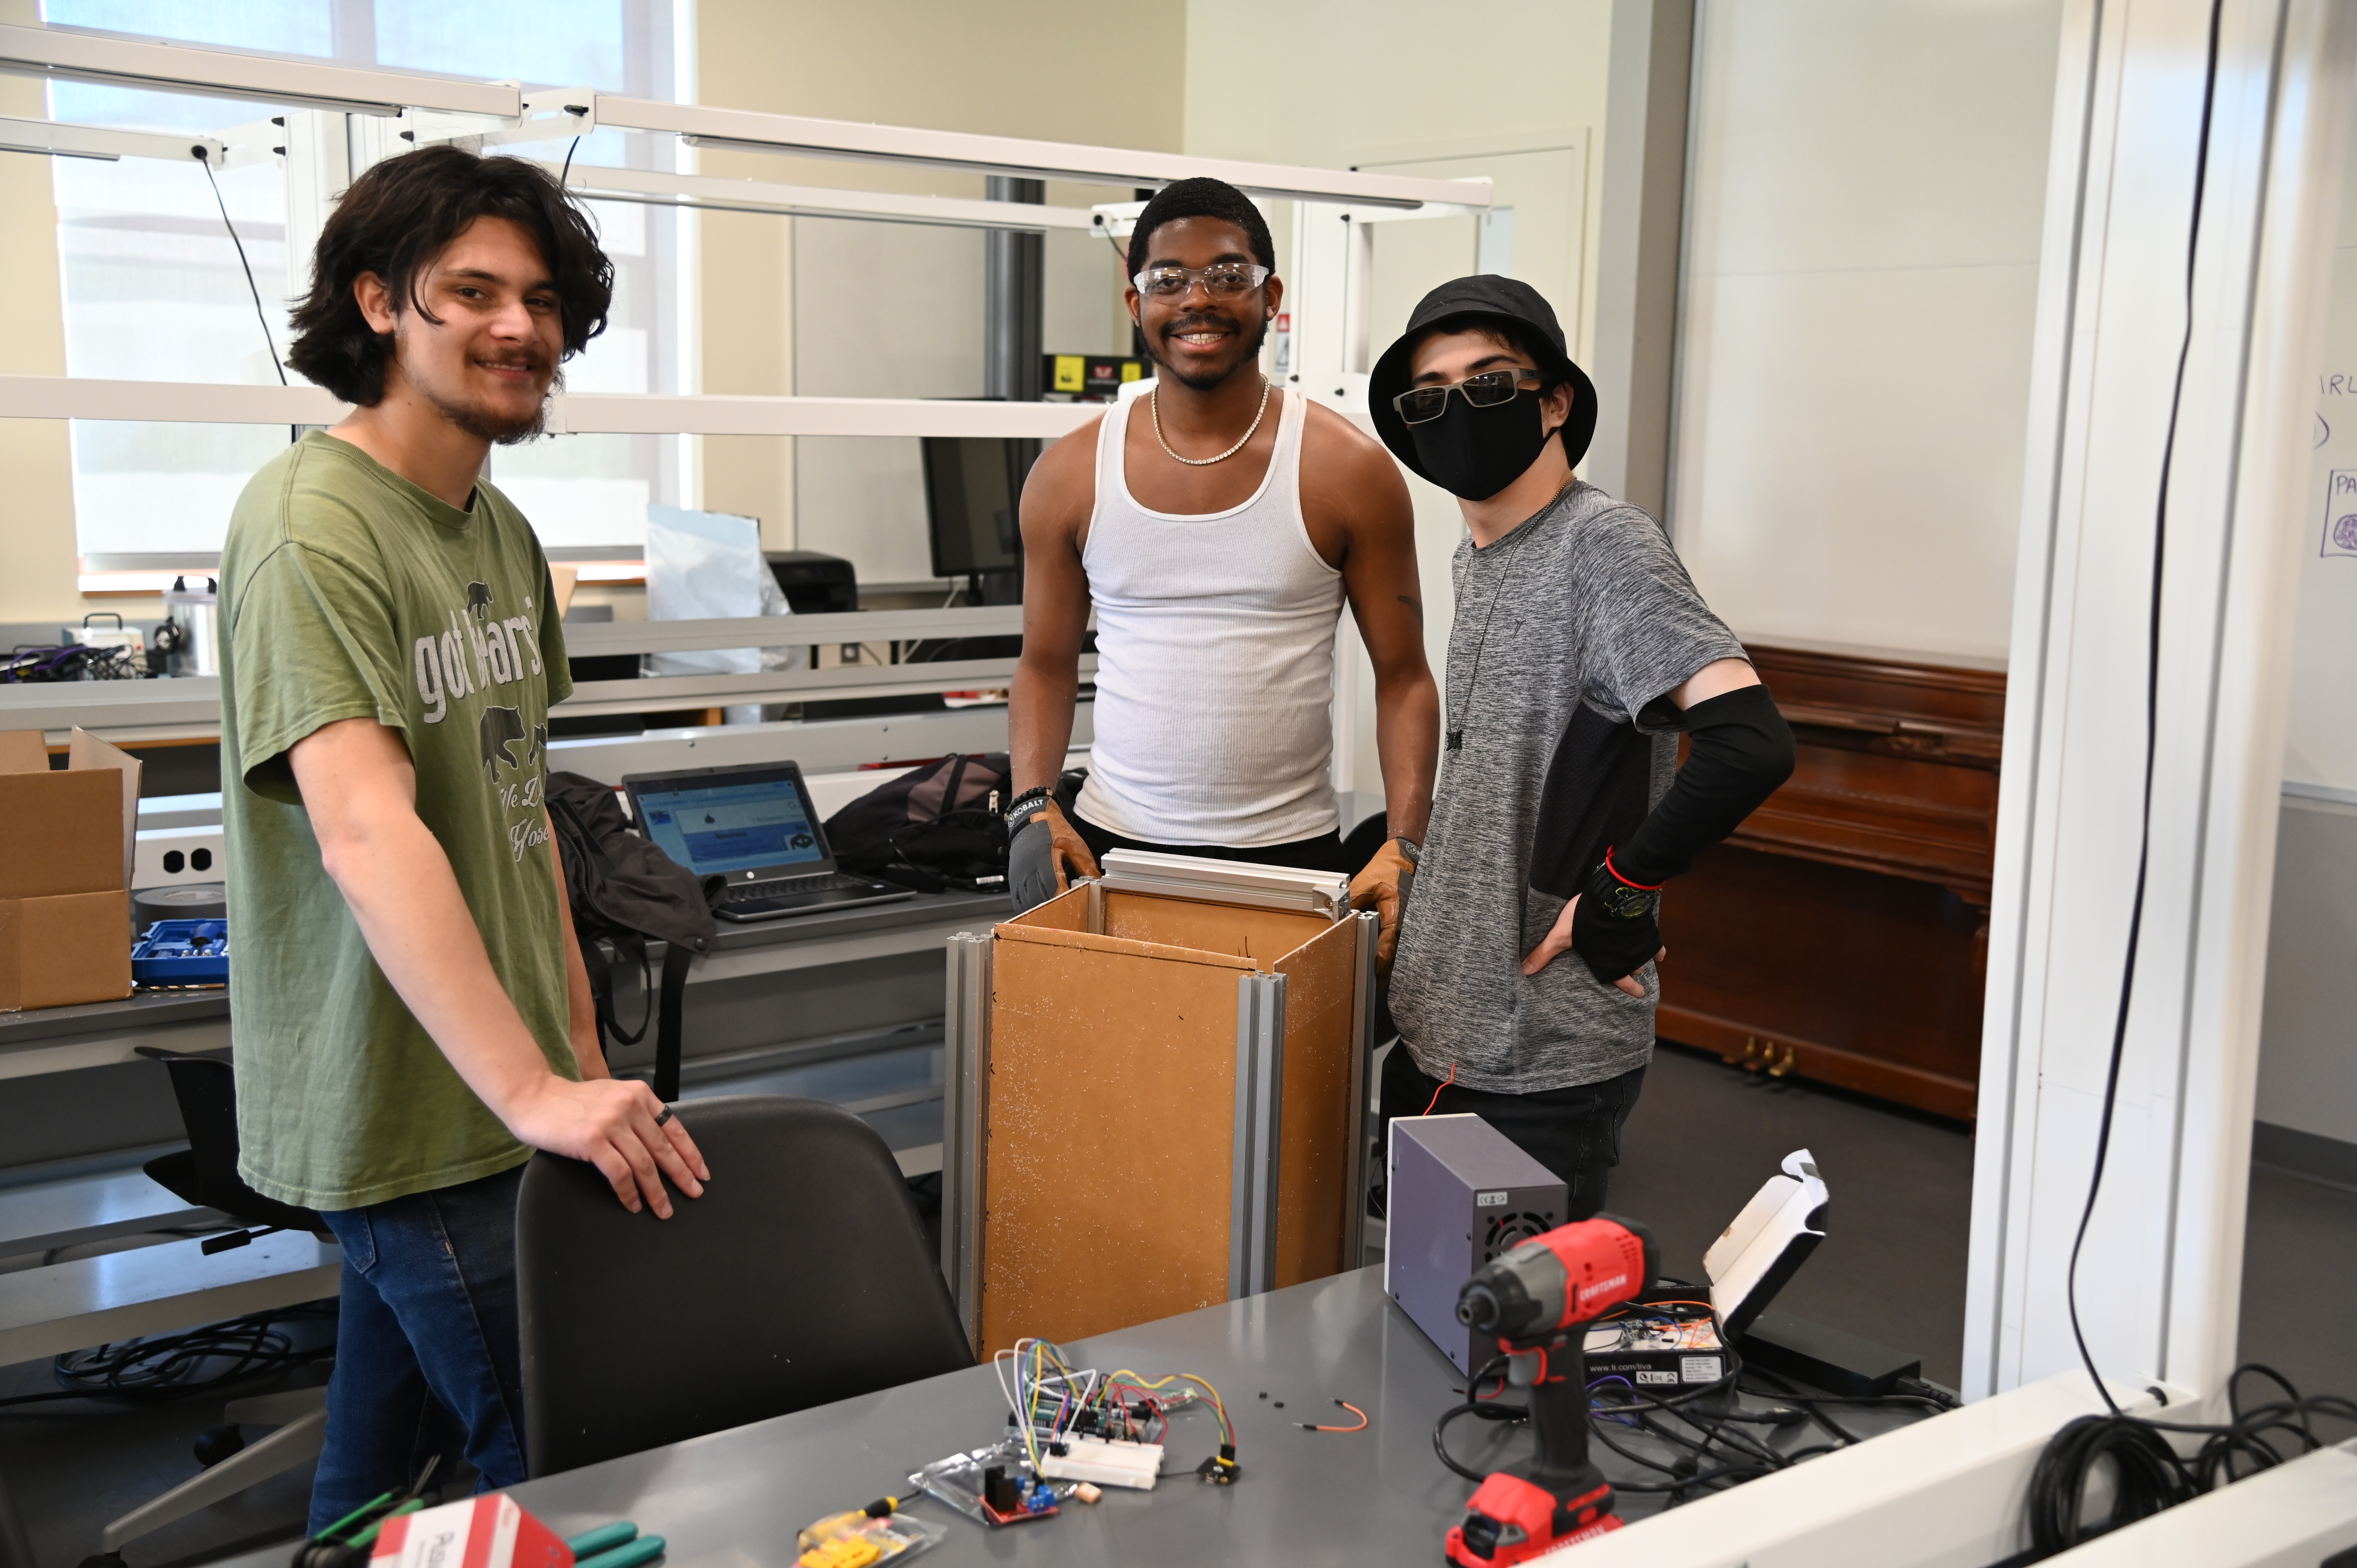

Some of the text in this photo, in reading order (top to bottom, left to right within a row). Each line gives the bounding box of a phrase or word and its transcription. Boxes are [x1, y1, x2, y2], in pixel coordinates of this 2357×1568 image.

[415, 610, 475, 724] got
[1013, 799, 1043, 818] KOBALT
[1590, 1363, 1652, 1372] www.ti.com/tiva
